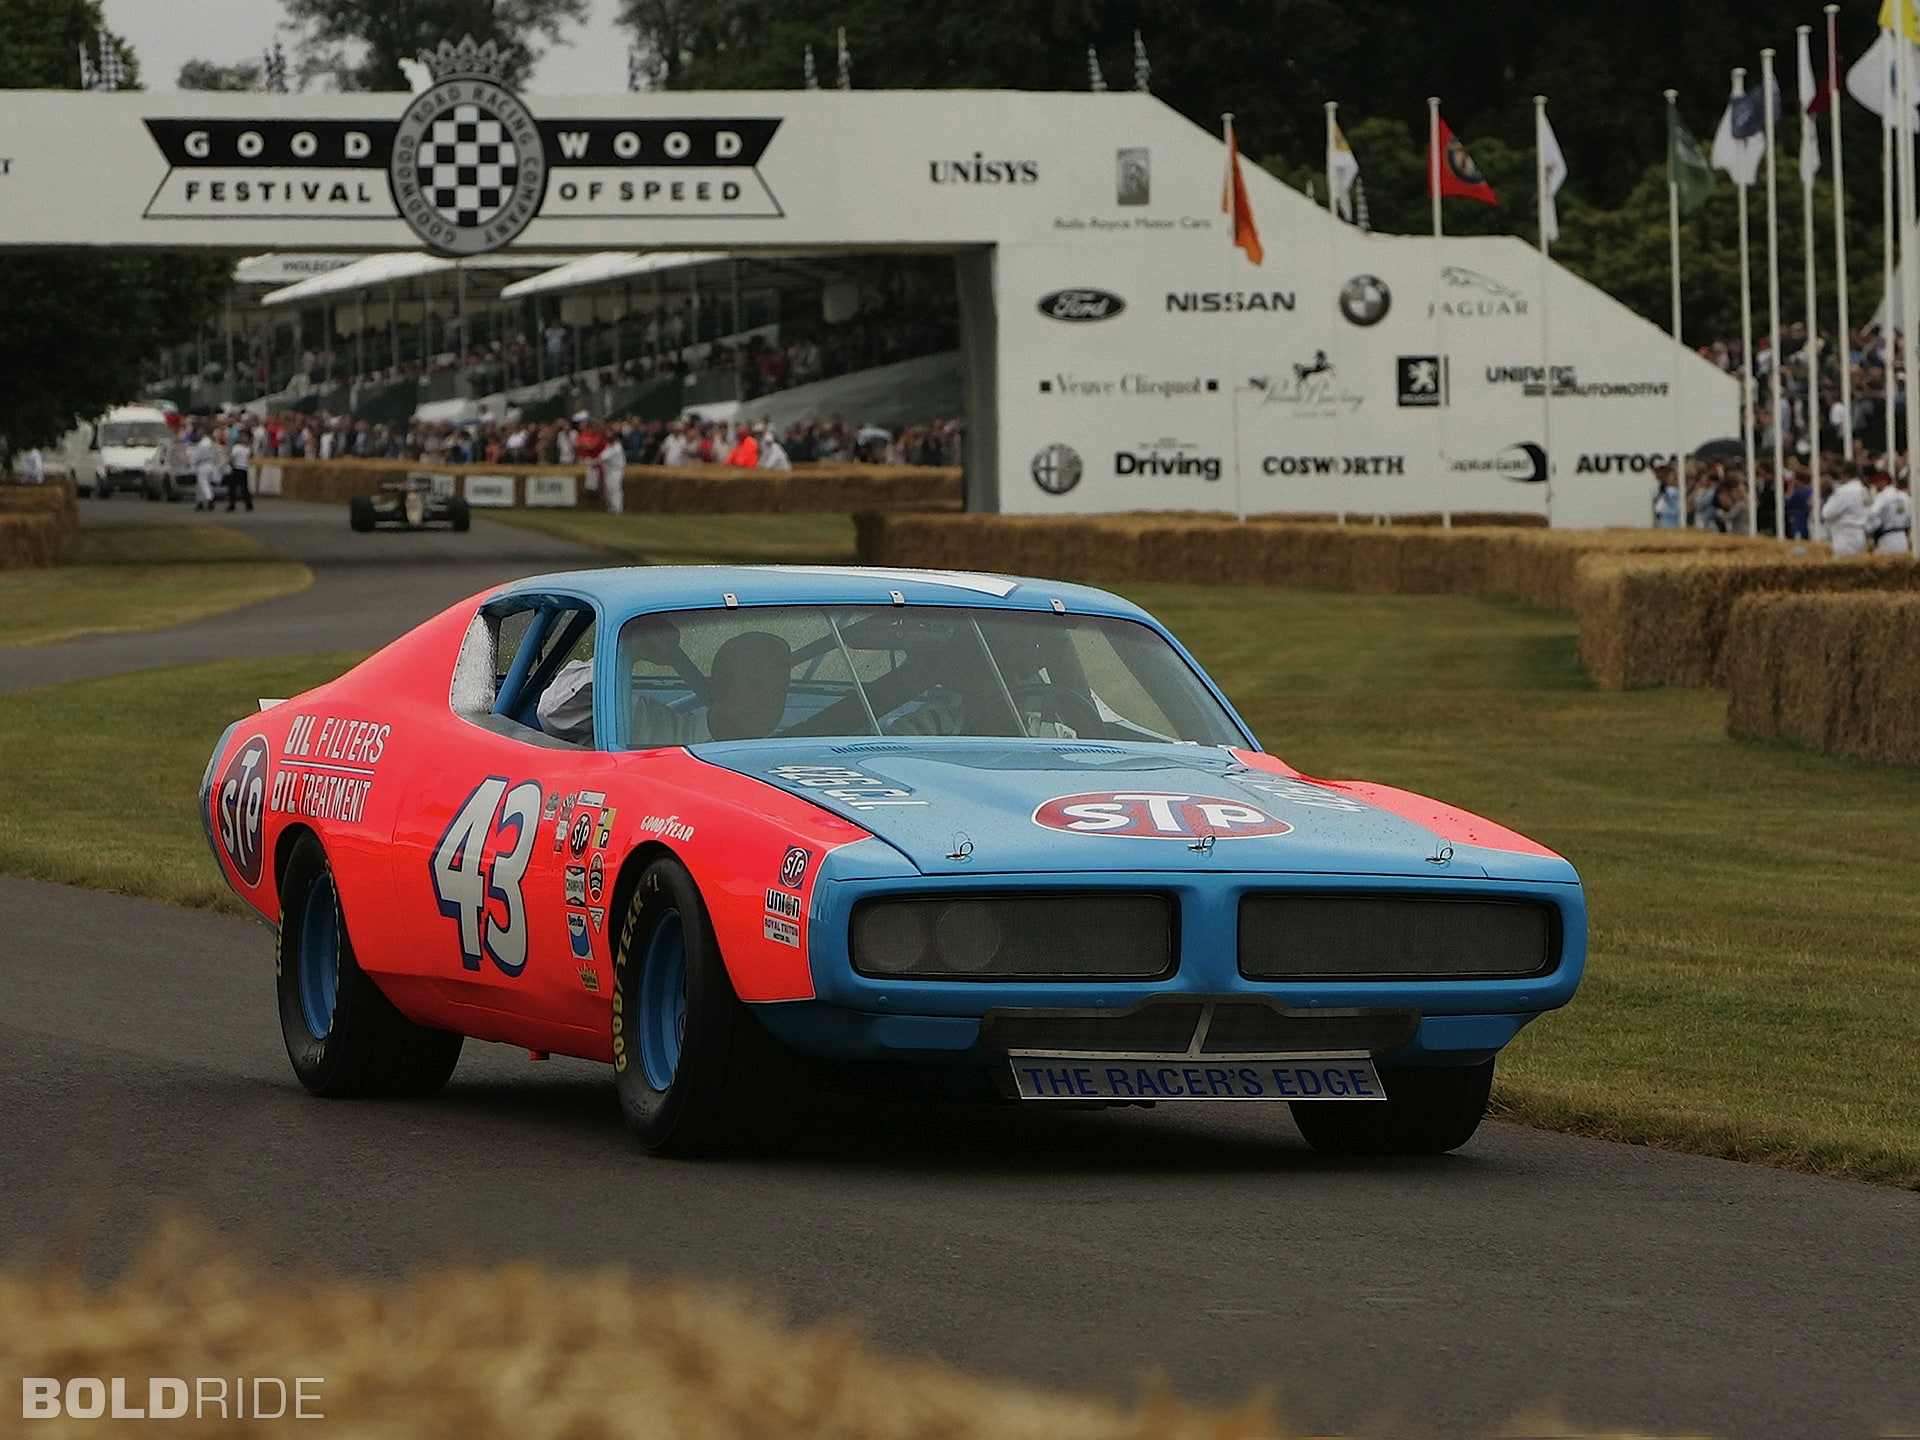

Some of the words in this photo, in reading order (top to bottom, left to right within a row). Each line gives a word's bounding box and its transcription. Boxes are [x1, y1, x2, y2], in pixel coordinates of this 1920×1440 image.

[183, 131, 372, 159] GOOD
[557, 131, 743, 159] WOOD
[185, 181, 372, 202] FESTIVAL
[559, 181, 602, 201] OF
[618, 181, 741, 202] SPEED
[1053, 292, 1110, 318] Ford
[1166, 291, 1296, 312] NISSAN
[1427, 301, 1529, 318] JAGUAR
[1114, 451, 1221, 481] Driving
[284, 715, 317, 756] OIL
[315, 717, 391, 764] FILTERS
[221, 749, 263, 868] STP
[271, 770, 299, 814] OIL
[298, 772, 371, 823] TREATMENT
[1062, 794, 1266, 832] STP
[640, 814, 695, 842] GOODYEAR
[429, 775, 543, 978] 43
[783, 850, 805, 879] STP
[1022, 1068, 1098, 1095] THE
[1105, 1068, 1264, 1096] RACER'S
[1273, 1068, 1374, 1096] EDGE
